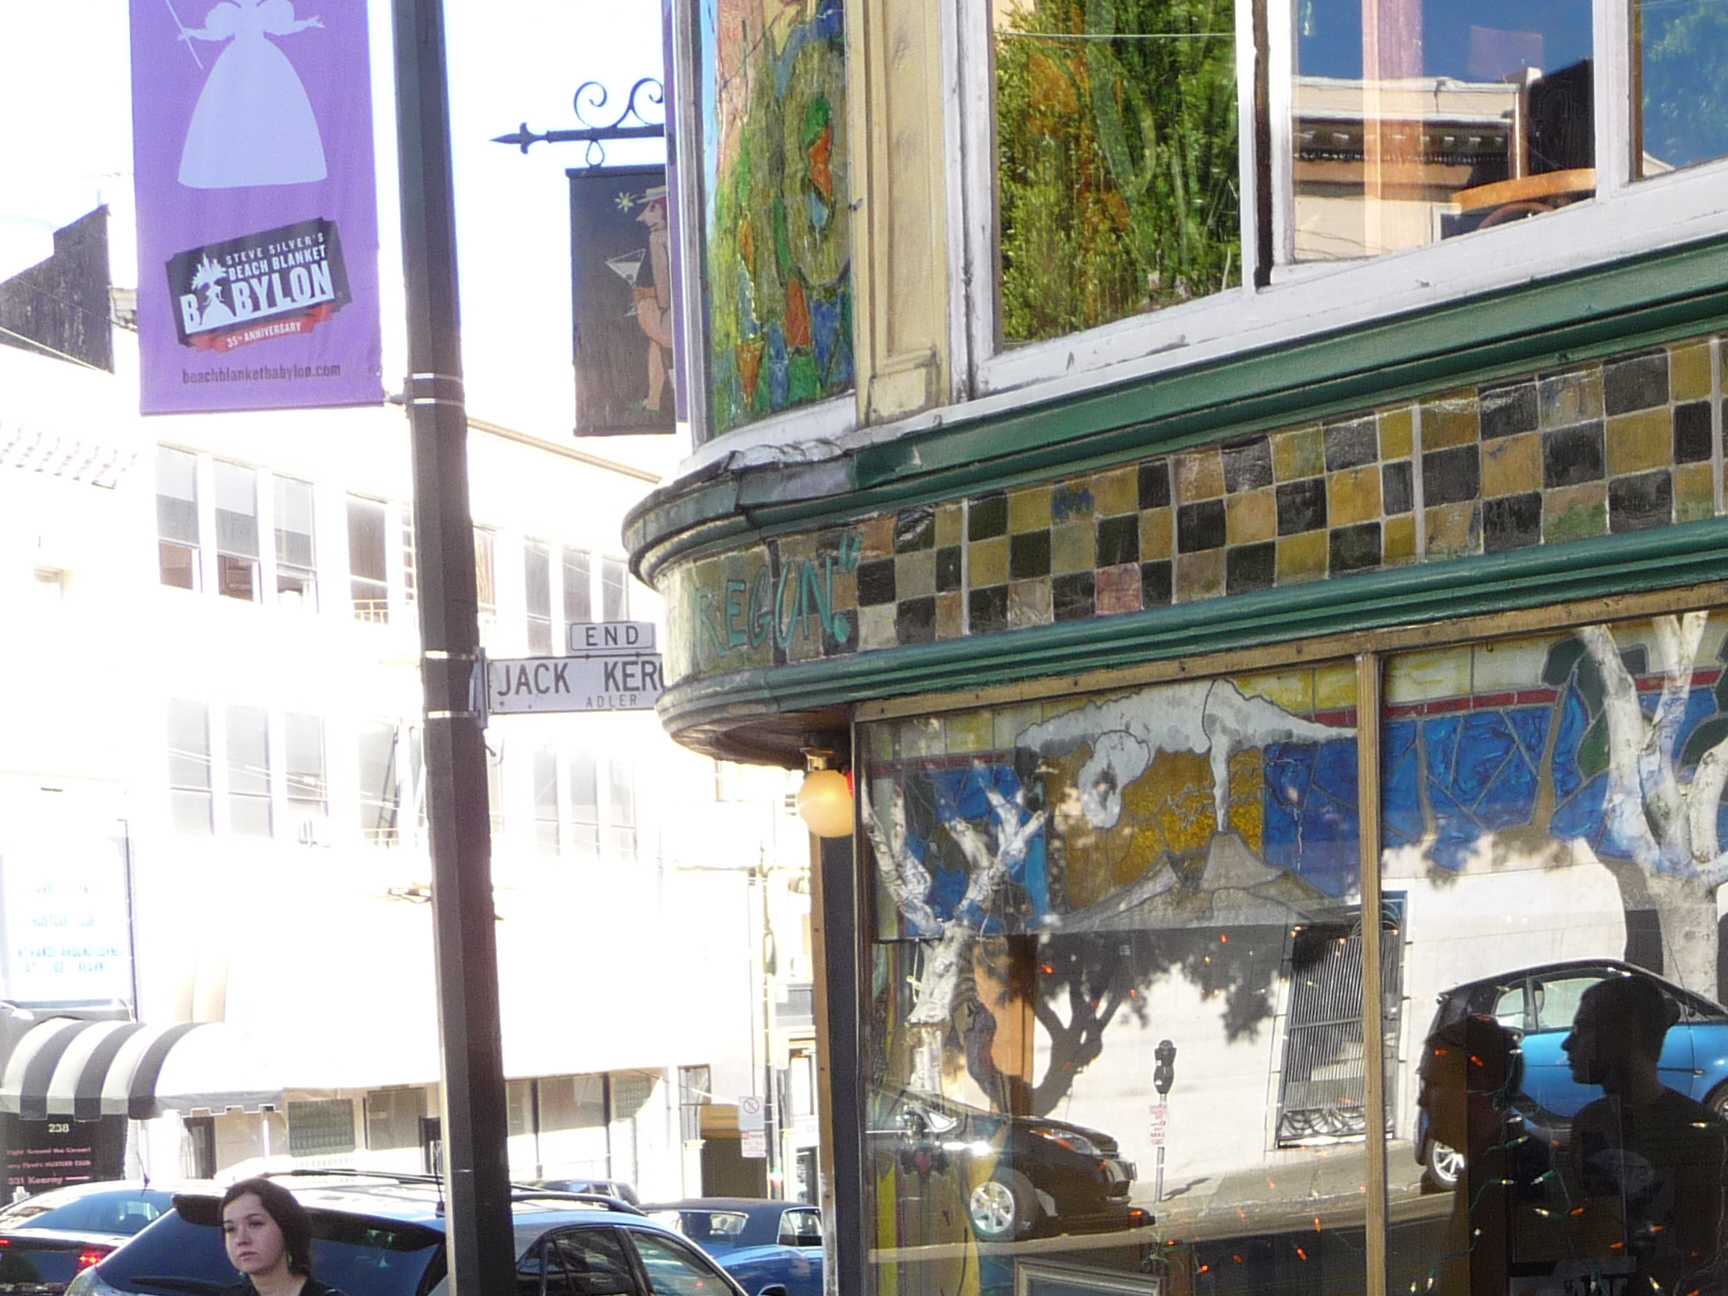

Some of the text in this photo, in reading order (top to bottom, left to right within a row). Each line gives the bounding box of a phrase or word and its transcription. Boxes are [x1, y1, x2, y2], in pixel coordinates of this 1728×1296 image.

[226, 232, 324, 265] STEVE SILVER'S
[228, 245, 326, 281] BEACH BLANKET
[244, 321, 302, 342] ANNIVERSARY
[182, 363, 341, 384] beachblanketbabylon.com
[585, 625, 639, 647] END
[497, 662, 571, 697] JACK
[586, 693, 638, 708] ADLER
[48, 1123, 70, 1133] 238
